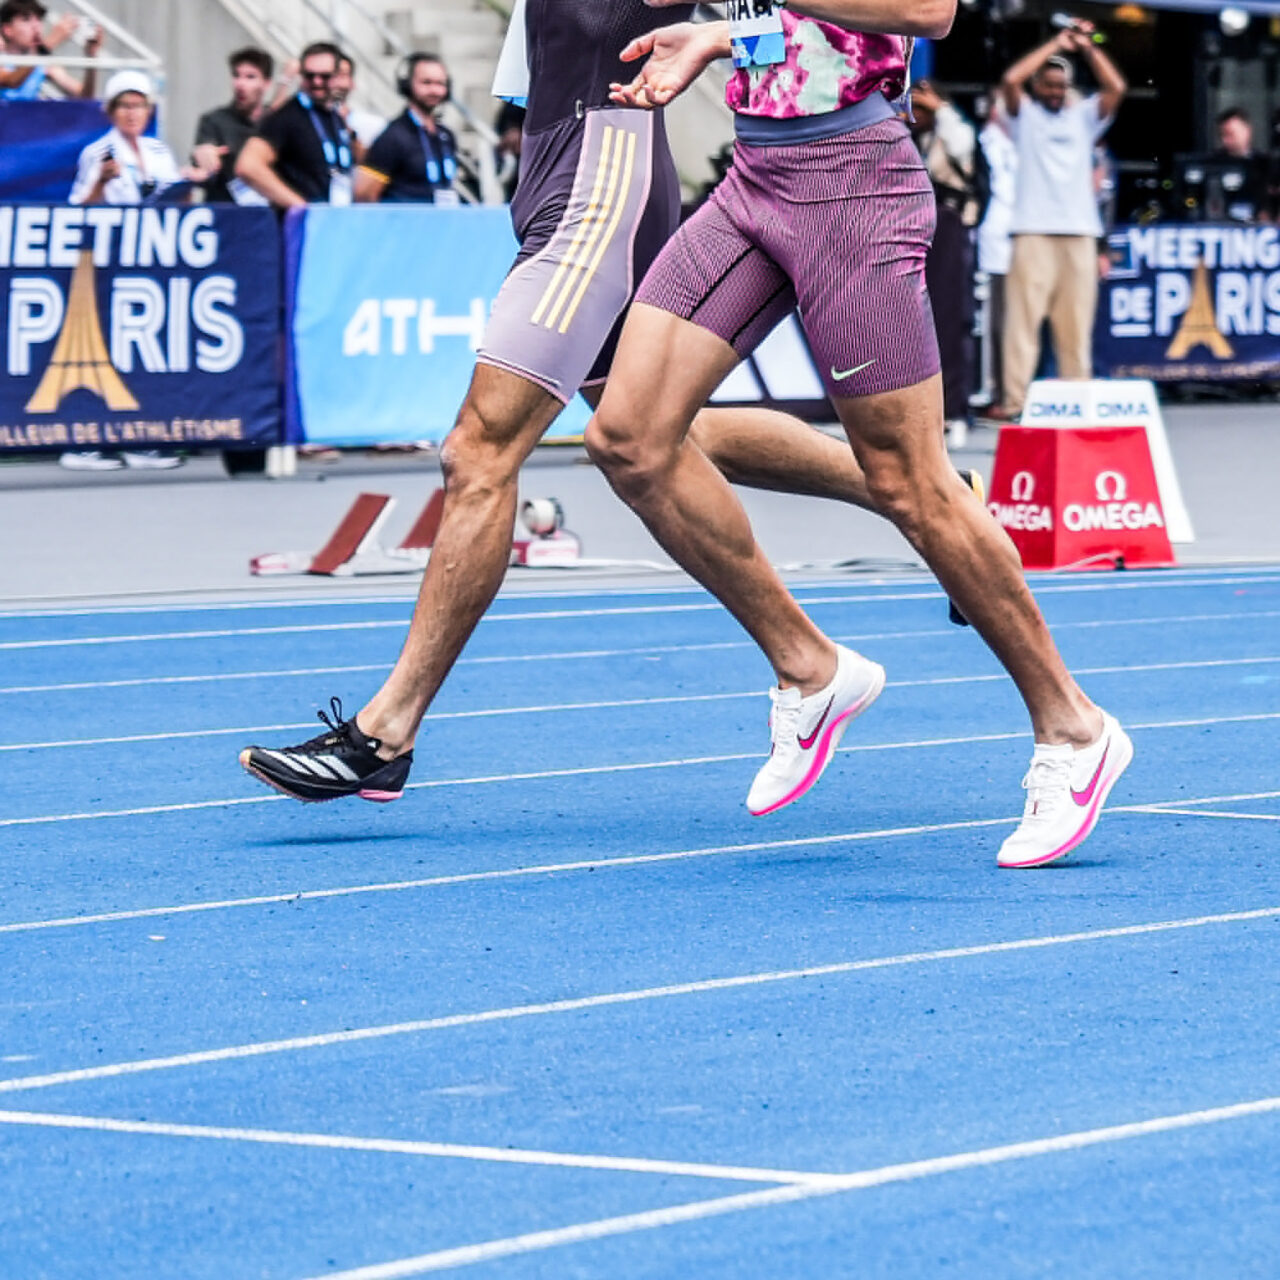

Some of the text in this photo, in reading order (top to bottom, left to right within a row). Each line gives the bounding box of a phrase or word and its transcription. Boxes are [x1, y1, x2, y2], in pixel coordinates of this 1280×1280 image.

[1110, 287, 1152, 333] DE
[8, 275, 244, 412] PARIS
[73, 422, 99, 444] DE
[988, 502, 1053, 531] OMEGA
[1063, 502, 1164, 532] OMEGA
